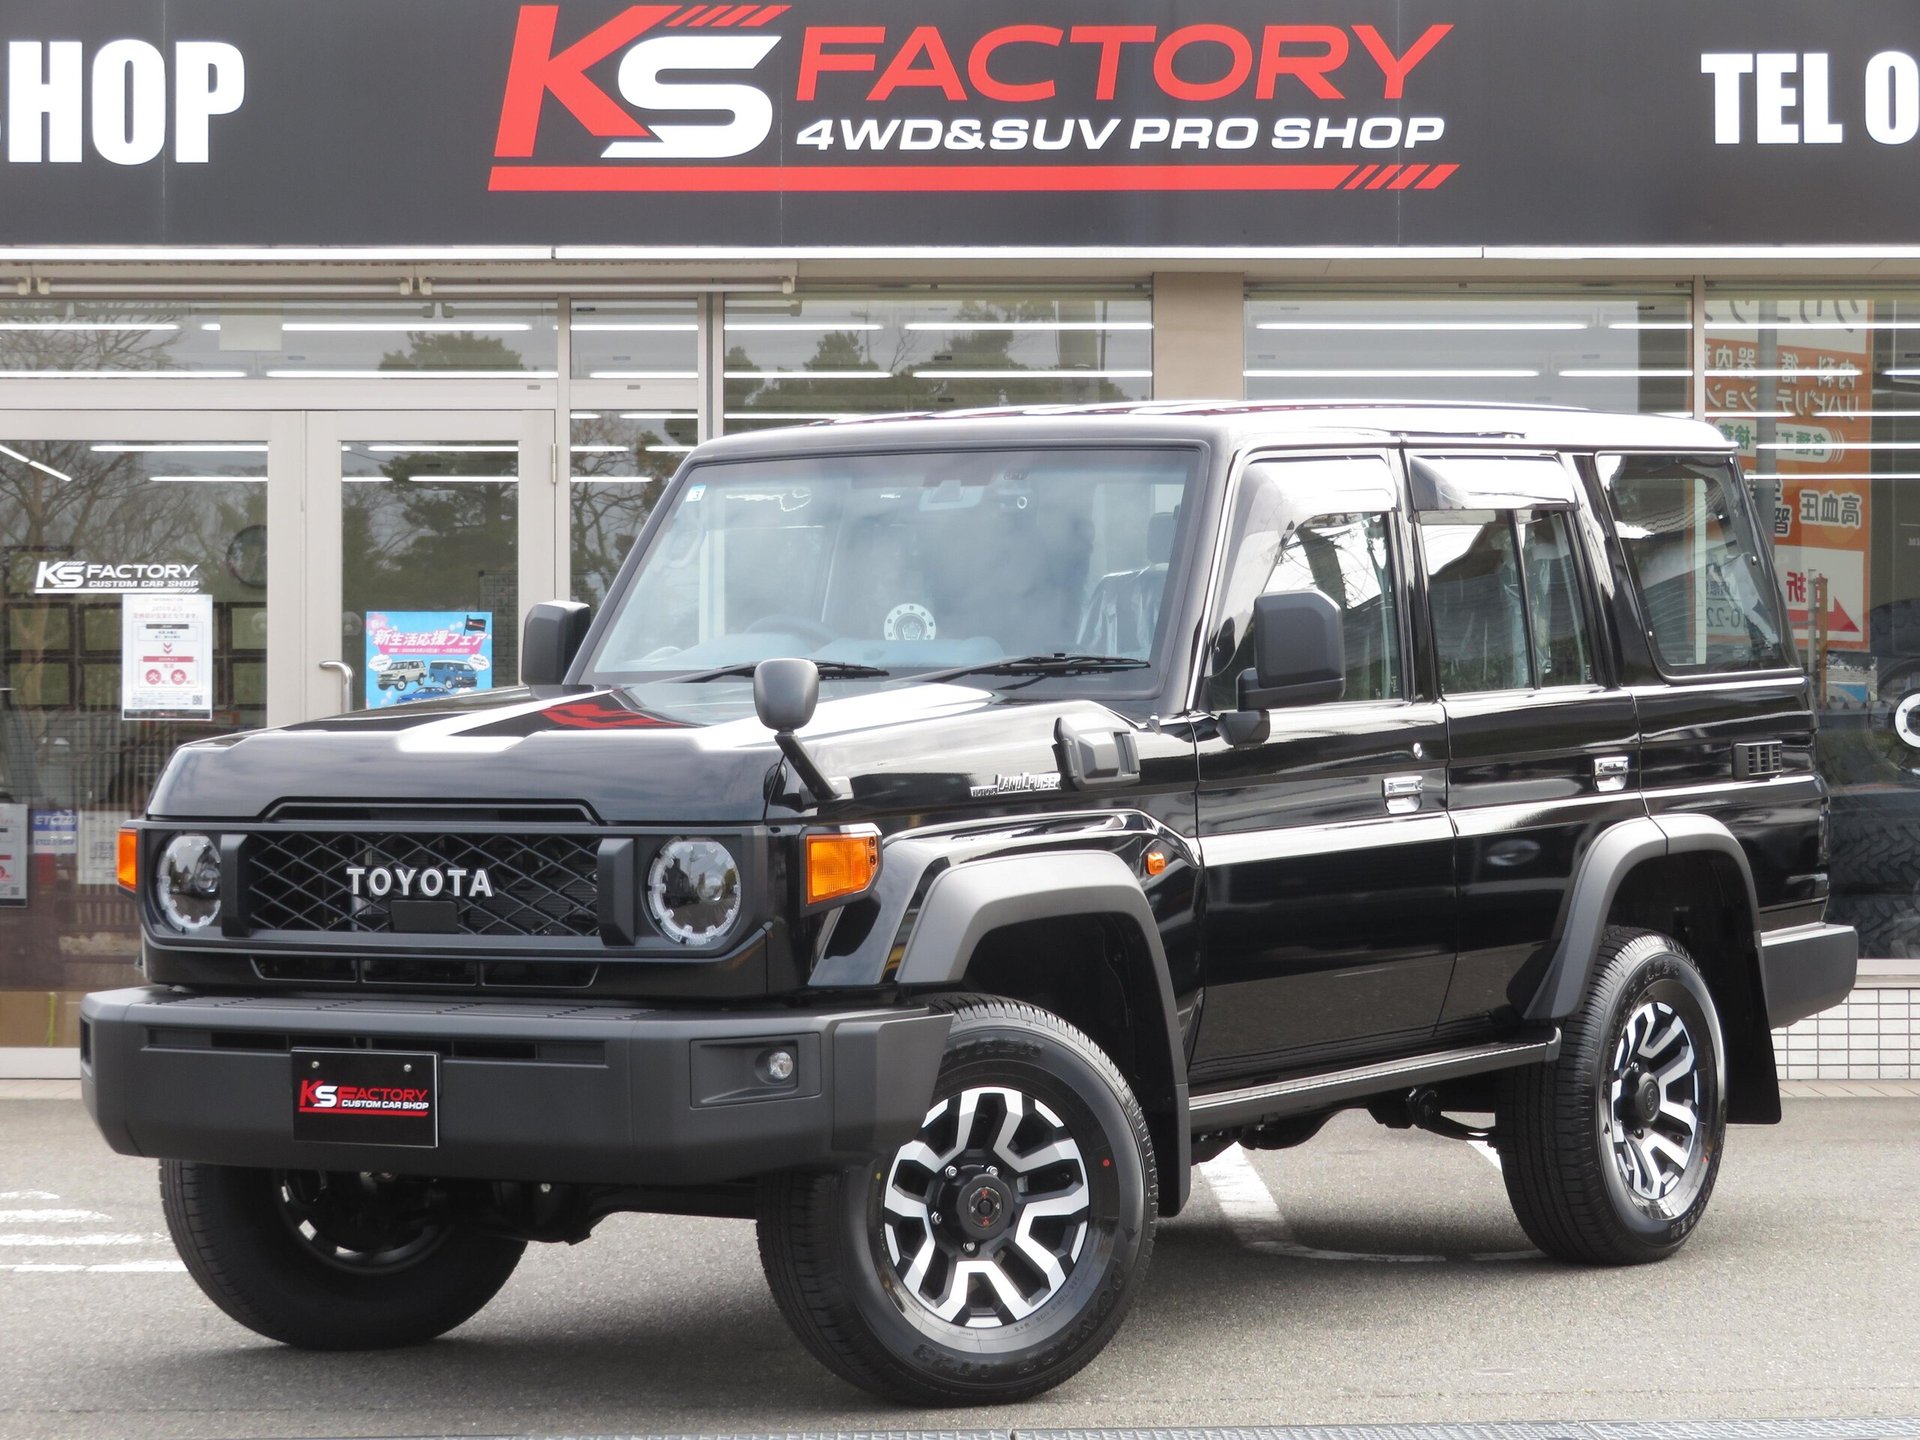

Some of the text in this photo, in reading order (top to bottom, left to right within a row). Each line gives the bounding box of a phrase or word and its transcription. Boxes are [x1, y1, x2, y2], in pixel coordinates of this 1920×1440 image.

[797, 24, 1454, 101] FACTORY
[0, 39, 245, 165] HOP
[1701, 52, 1843, 144] TEL
[797, 117, 1445, 151] 4WD&SUV PRO SHOP
[86, 564, 198, 579] FACTORY
[88, 580, 199, 588] CUSTOM CAR SHOP
[373, 629, 487, 646] 新生活応援フェア
[347, 867, 493, 898] TOYOTA
[337, 1086, 428, 1107] FACTORY
[341, 1099, 429, 1110] CUSTOM CAR SHOP
